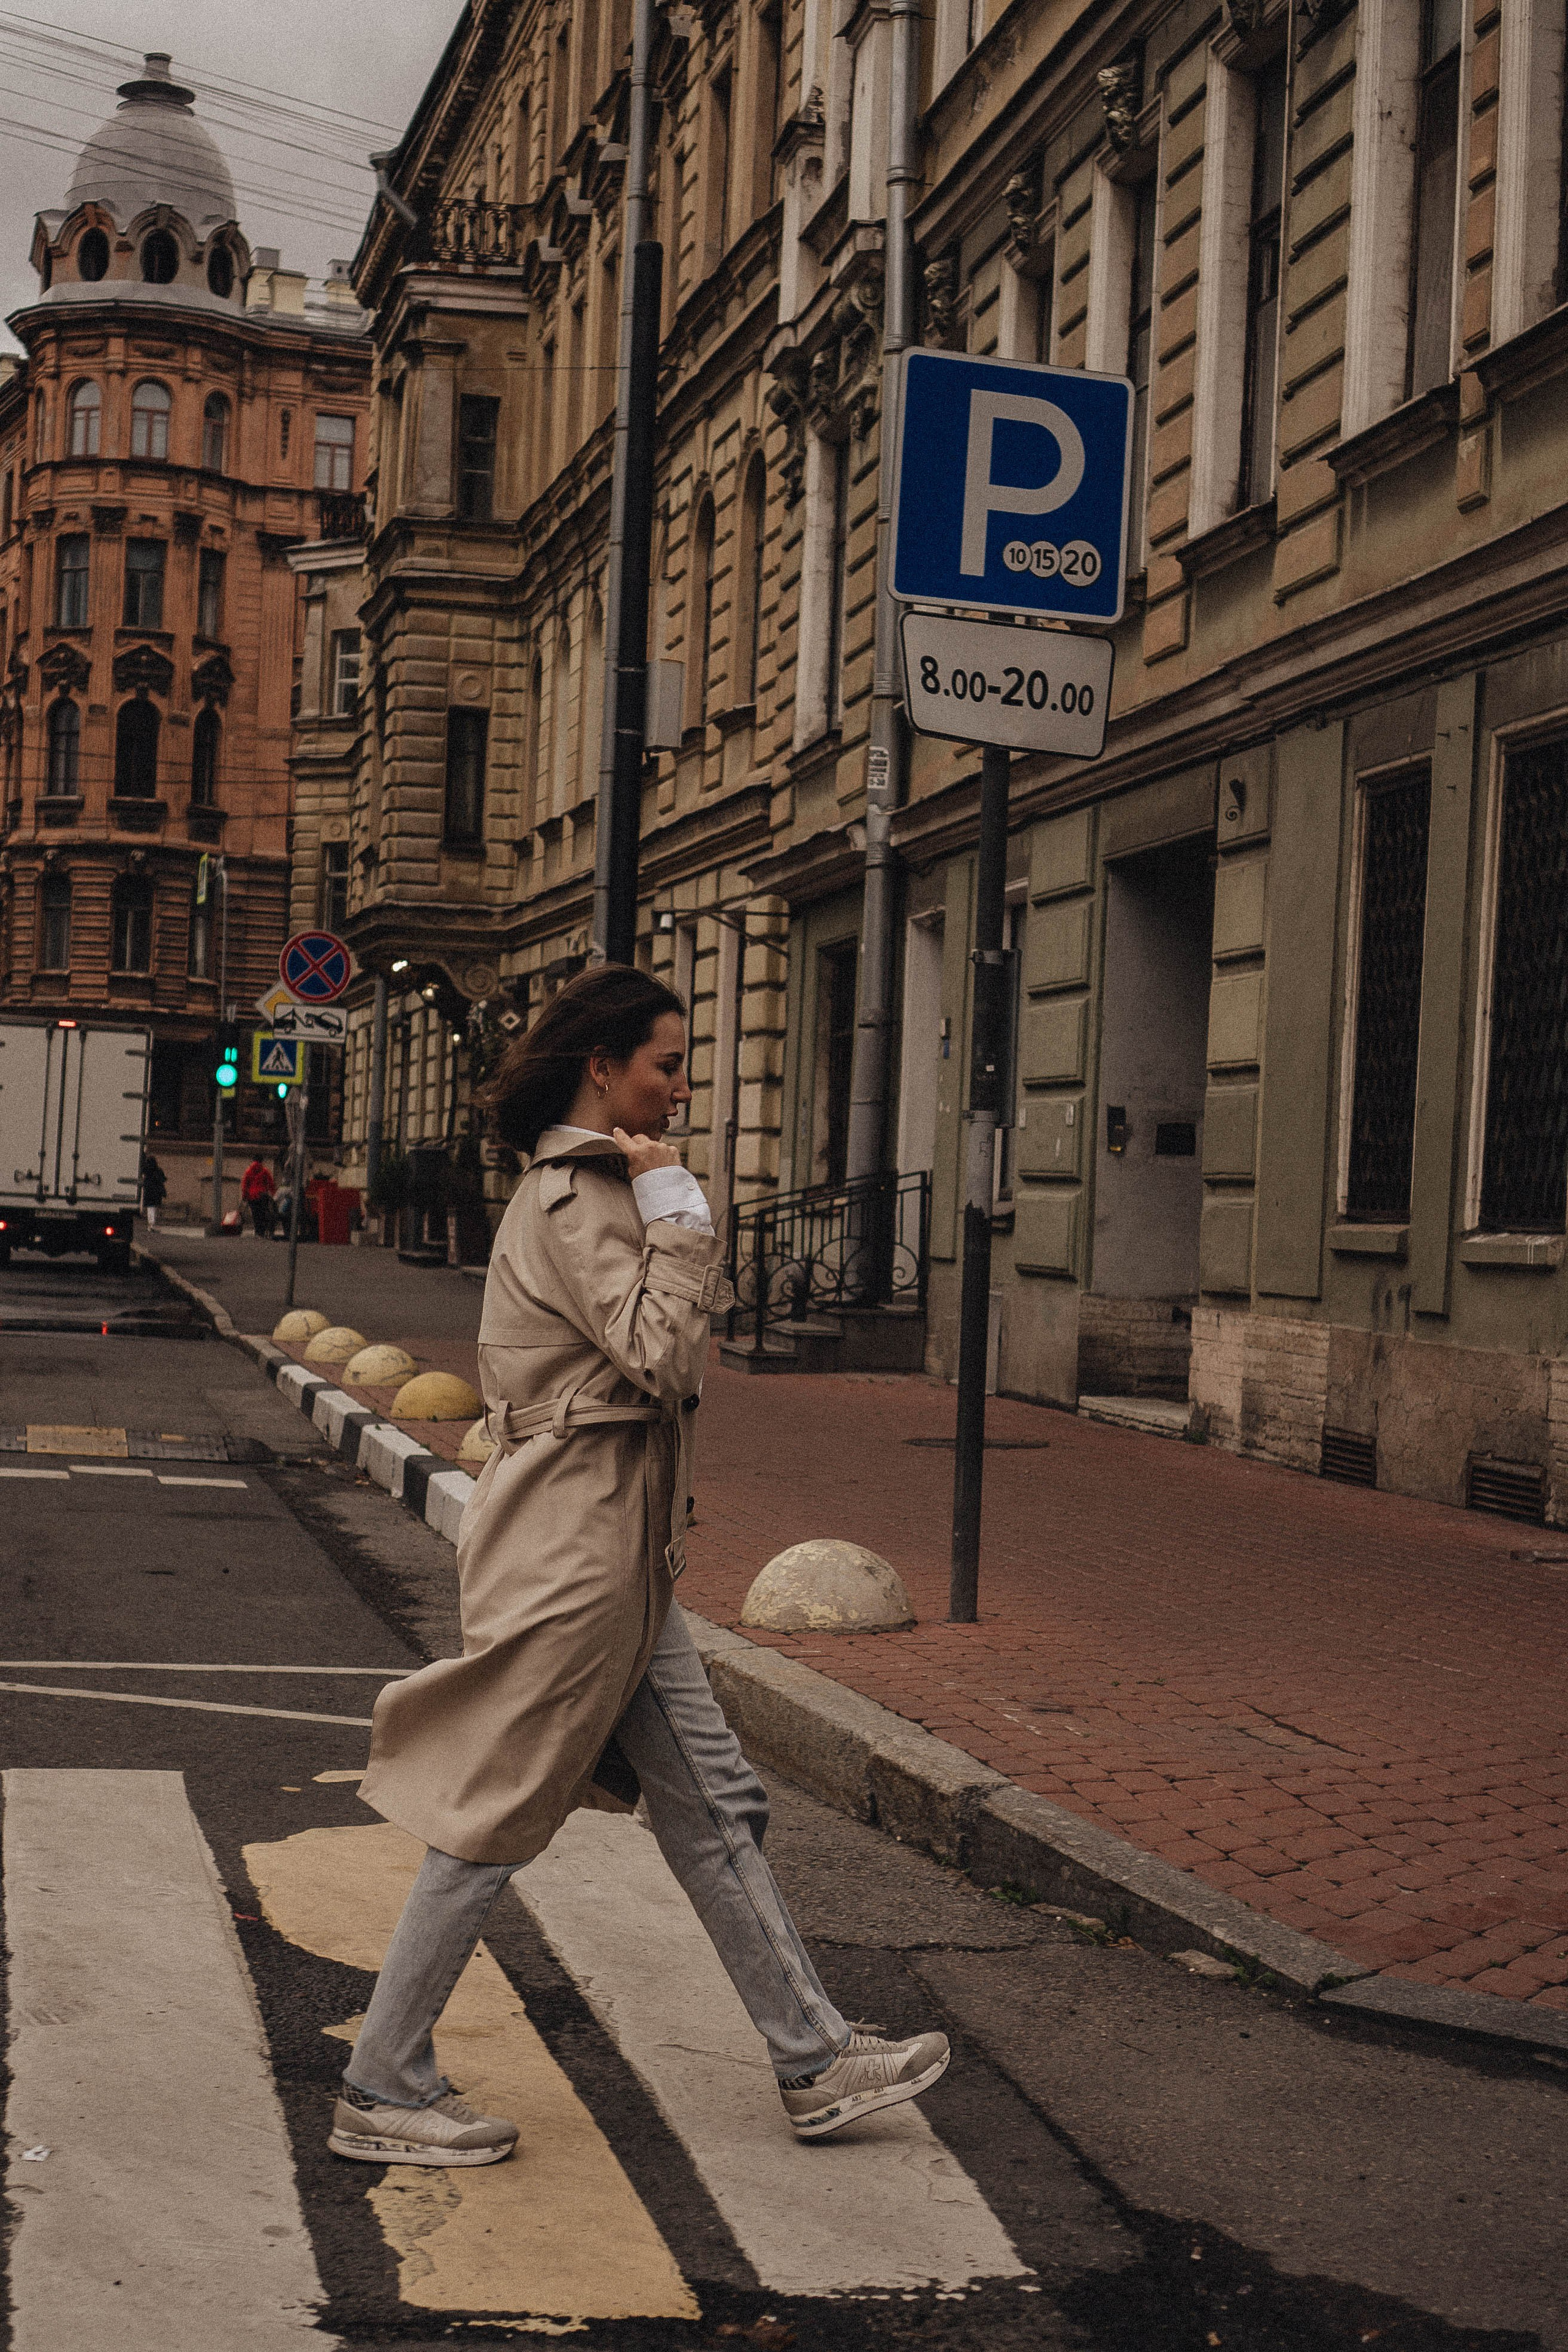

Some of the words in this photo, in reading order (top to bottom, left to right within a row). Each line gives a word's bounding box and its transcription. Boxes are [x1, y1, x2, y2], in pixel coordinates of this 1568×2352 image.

[959, 388, 1085, 577] P
[1009, 547, 1027, 565] 10
[1034, 548, 1055, 570] 15
[1063, 549, 1098, 577] 20
